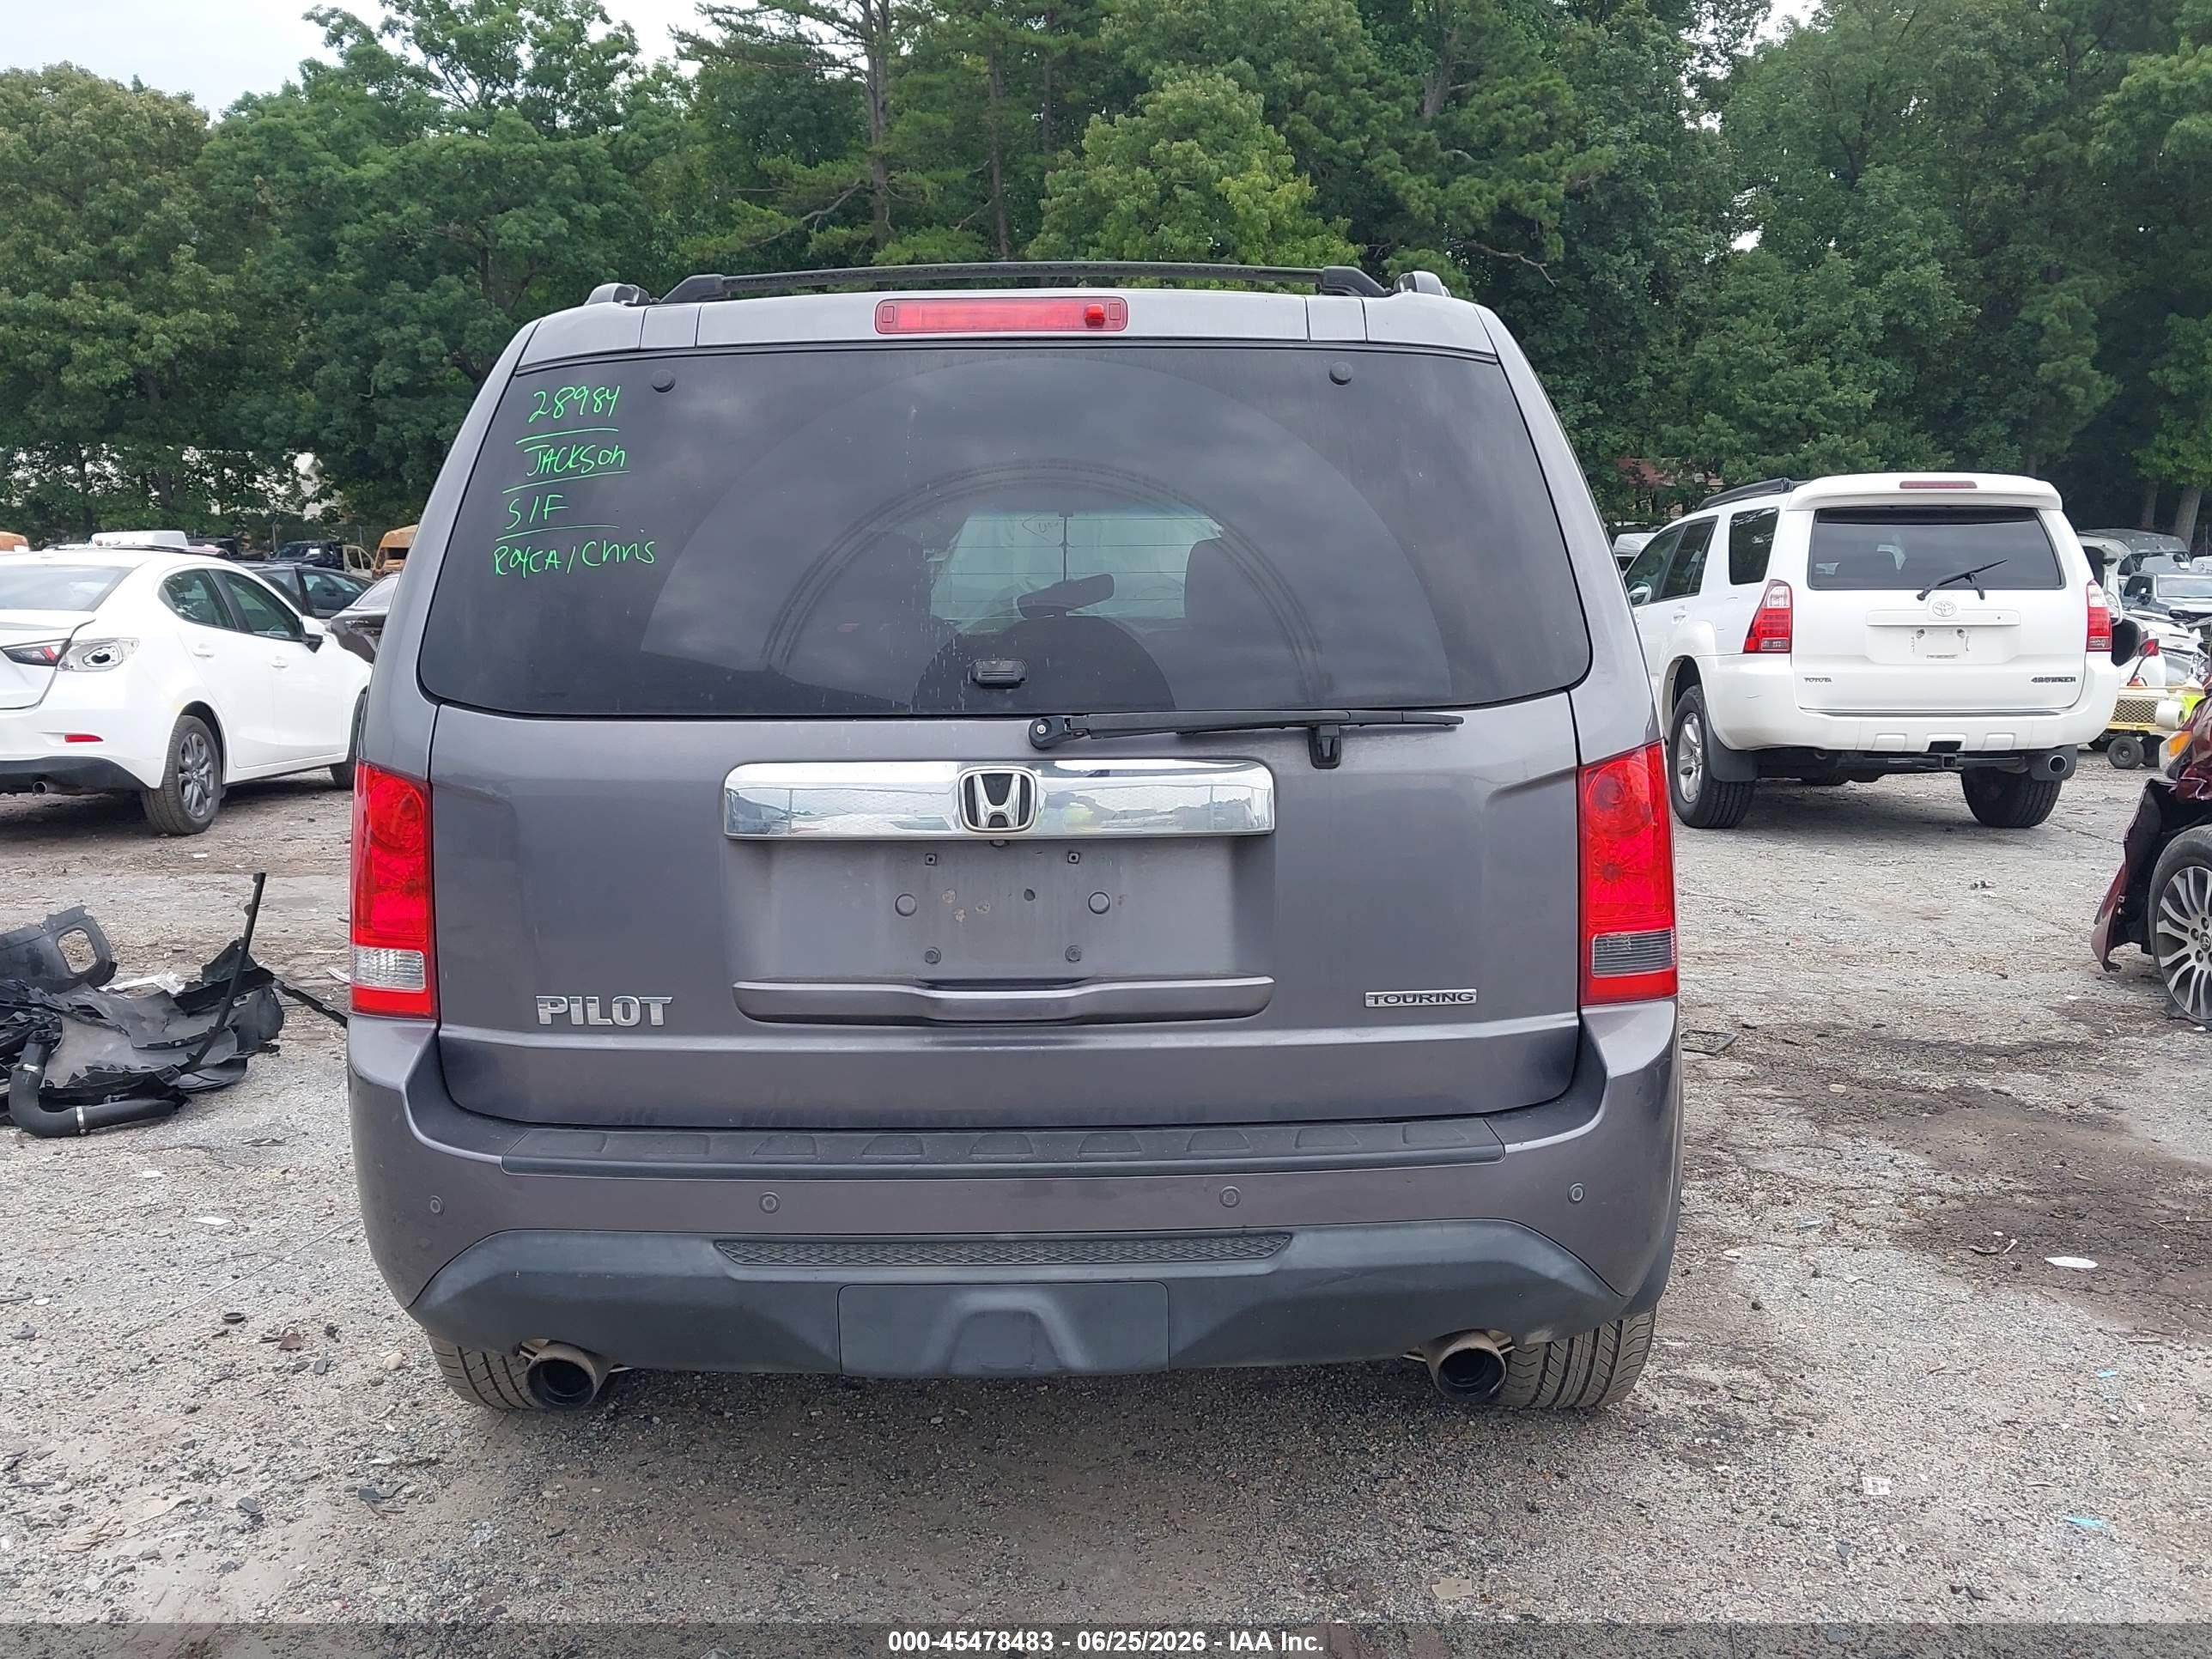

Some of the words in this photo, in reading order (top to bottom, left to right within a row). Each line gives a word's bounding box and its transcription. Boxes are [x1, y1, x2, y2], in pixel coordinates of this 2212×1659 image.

[528, 385, 620, 423] 28984
[535, 995, 673, 1027] PILOT
[1367, 991, 1474, 1006] TOURING
